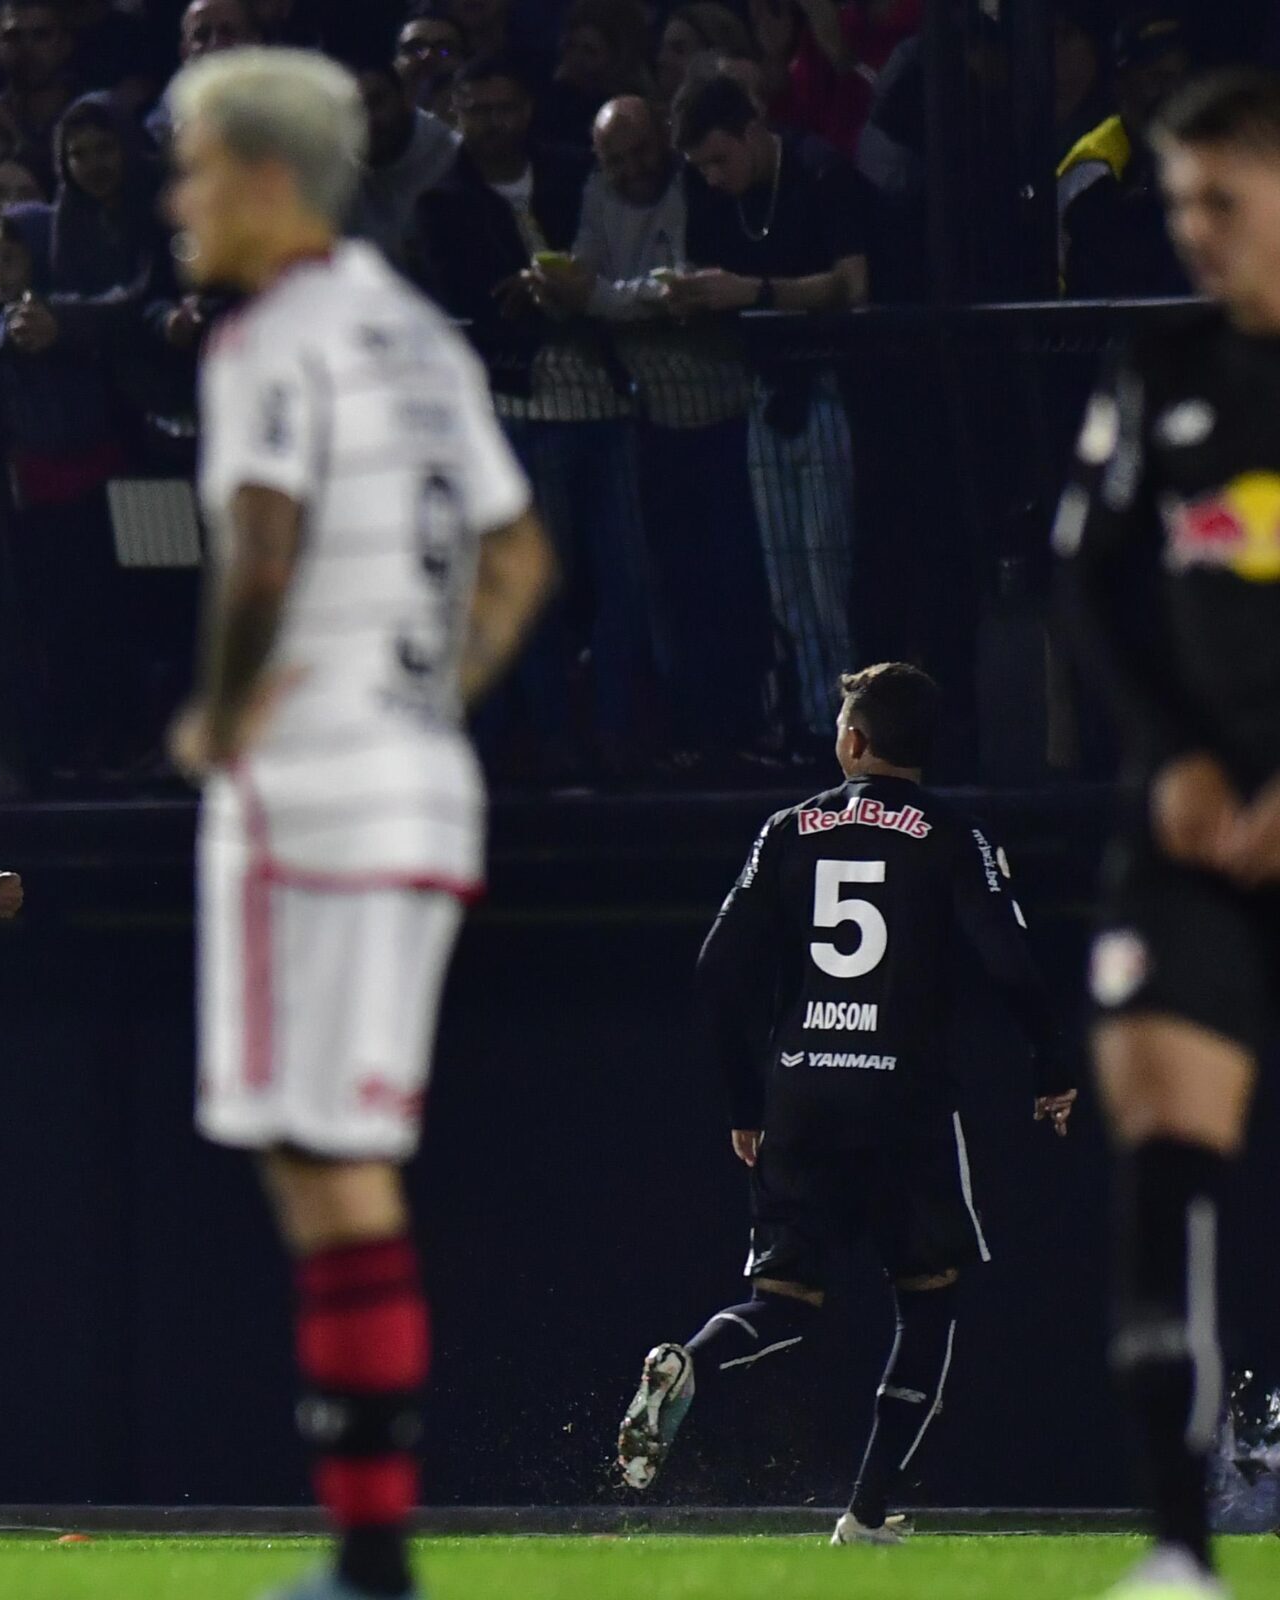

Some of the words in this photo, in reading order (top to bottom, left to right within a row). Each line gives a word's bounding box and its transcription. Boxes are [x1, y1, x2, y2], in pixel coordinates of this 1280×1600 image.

[809, 859, 888, 978] 5
[802, 1000, 878, 1032] JADSOM
[807, 1051, 898, 1071] YANMAR
